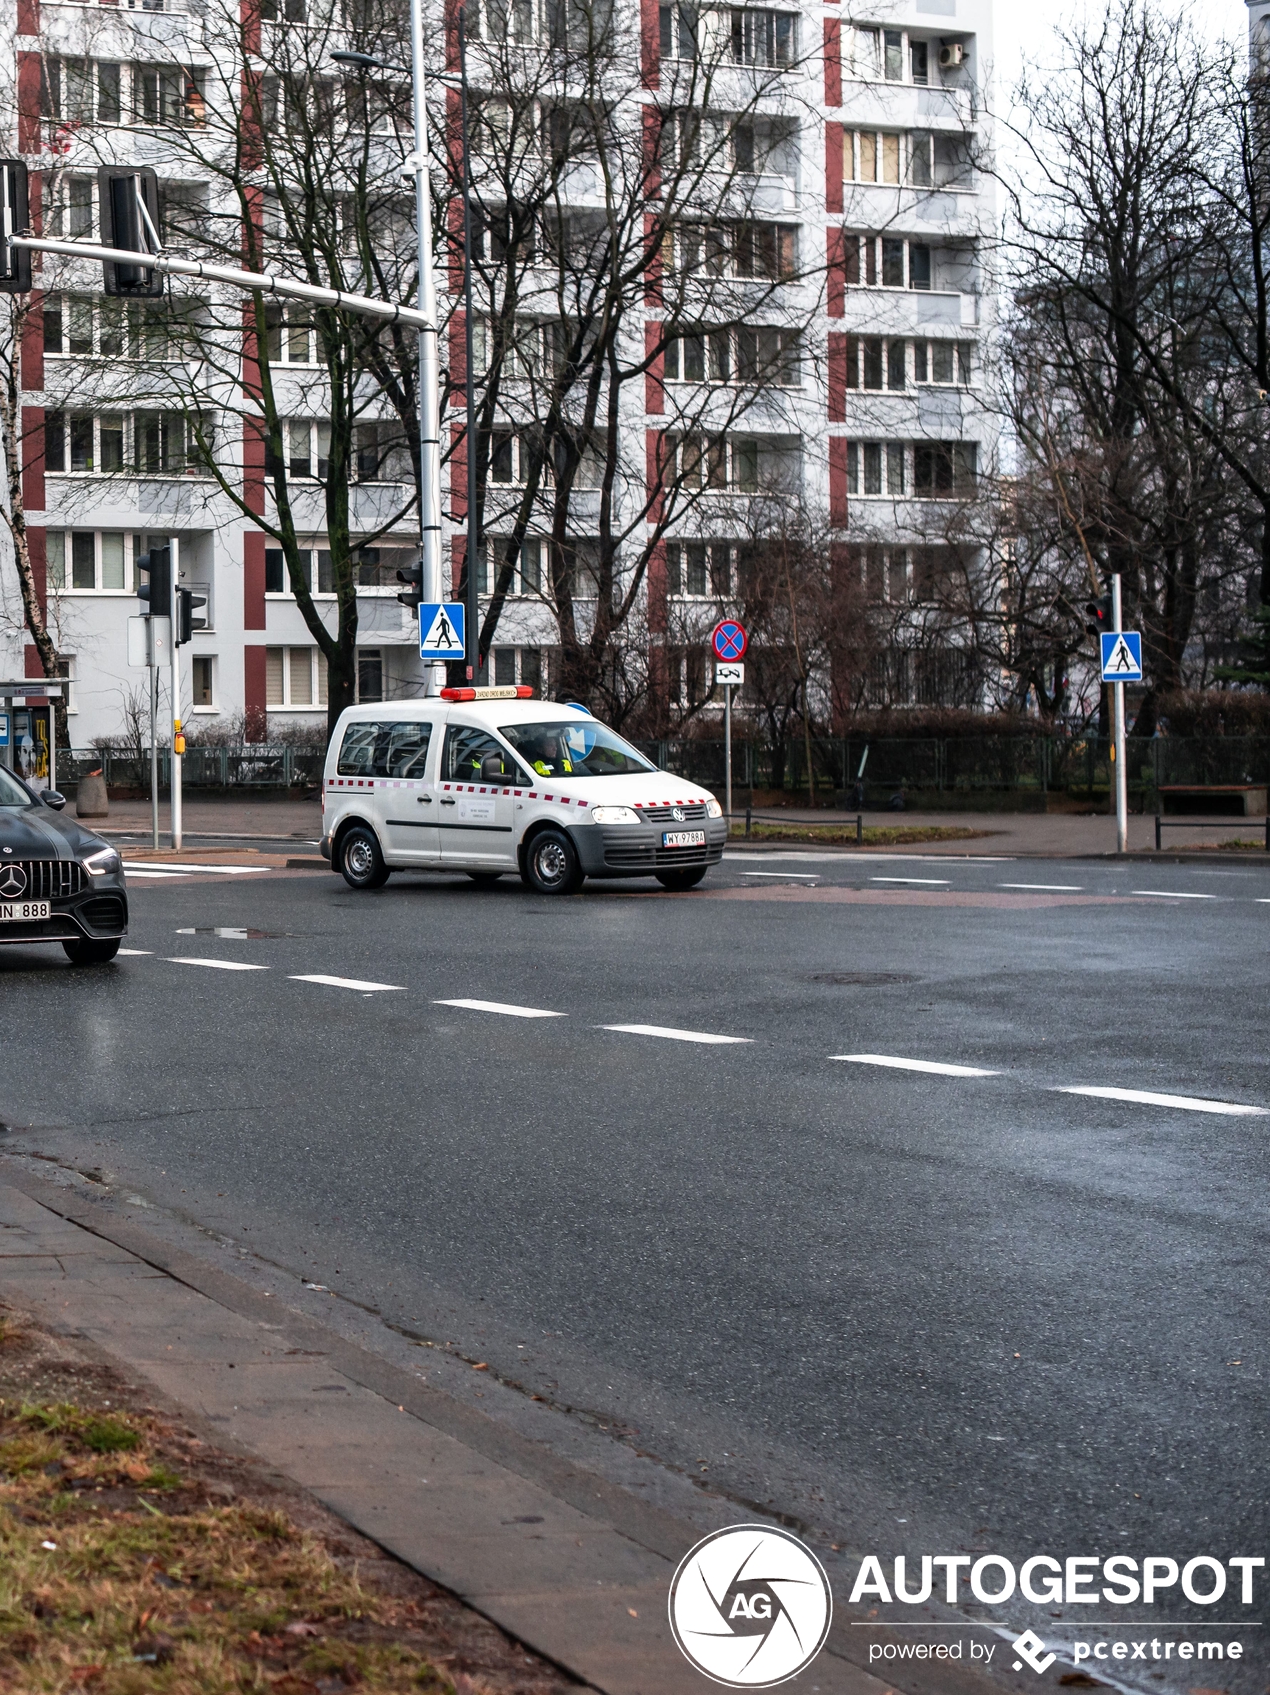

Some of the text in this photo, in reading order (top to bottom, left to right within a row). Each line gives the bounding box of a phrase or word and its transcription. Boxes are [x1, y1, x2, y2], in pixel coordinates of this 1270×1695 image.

[668, 832, 704, 843] WY 9788A
[22, 903, 47, 917] 888
